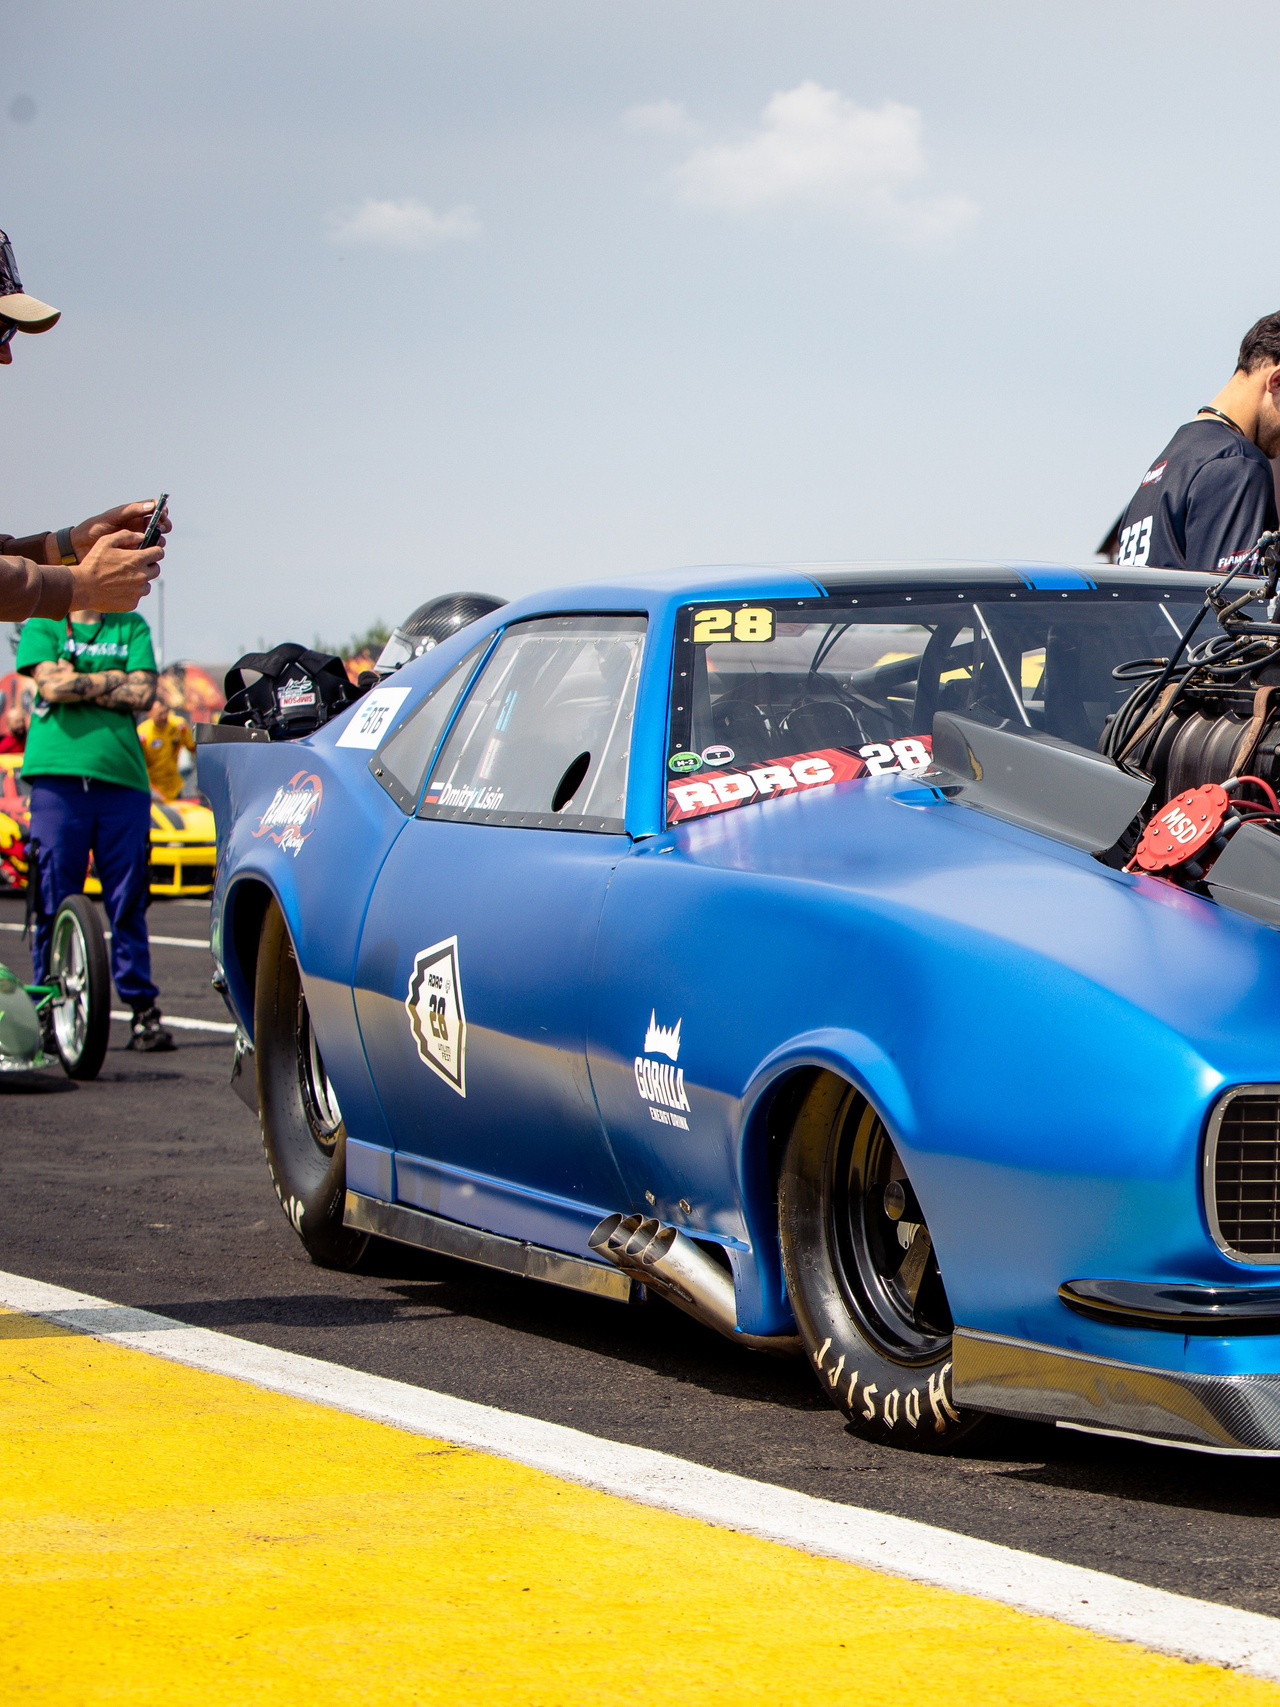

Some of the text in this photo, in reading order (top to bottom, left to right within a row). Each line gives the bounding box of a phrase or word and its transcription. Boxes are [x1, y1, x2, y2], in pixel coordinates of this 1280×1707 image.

[693, 607, 773, 642] 28
[283, 694, 313, 705] SIMPSON
[360, 707, 390, 734] ВТБ
[668, 739, 933, 812] RDRC 28
[677, 759, 695, 767] M-2
[438, 783, 504, 813] Dmitry Lisin
[1161, 807, 1197, 844] MSD
[278, 828, 304, 857] Racing
[429, 994, 449, 1041] 28
[634, 1056, 691, 1112] GORILLA
[649, 1106, 690, 1131] ENERGY DRINK
